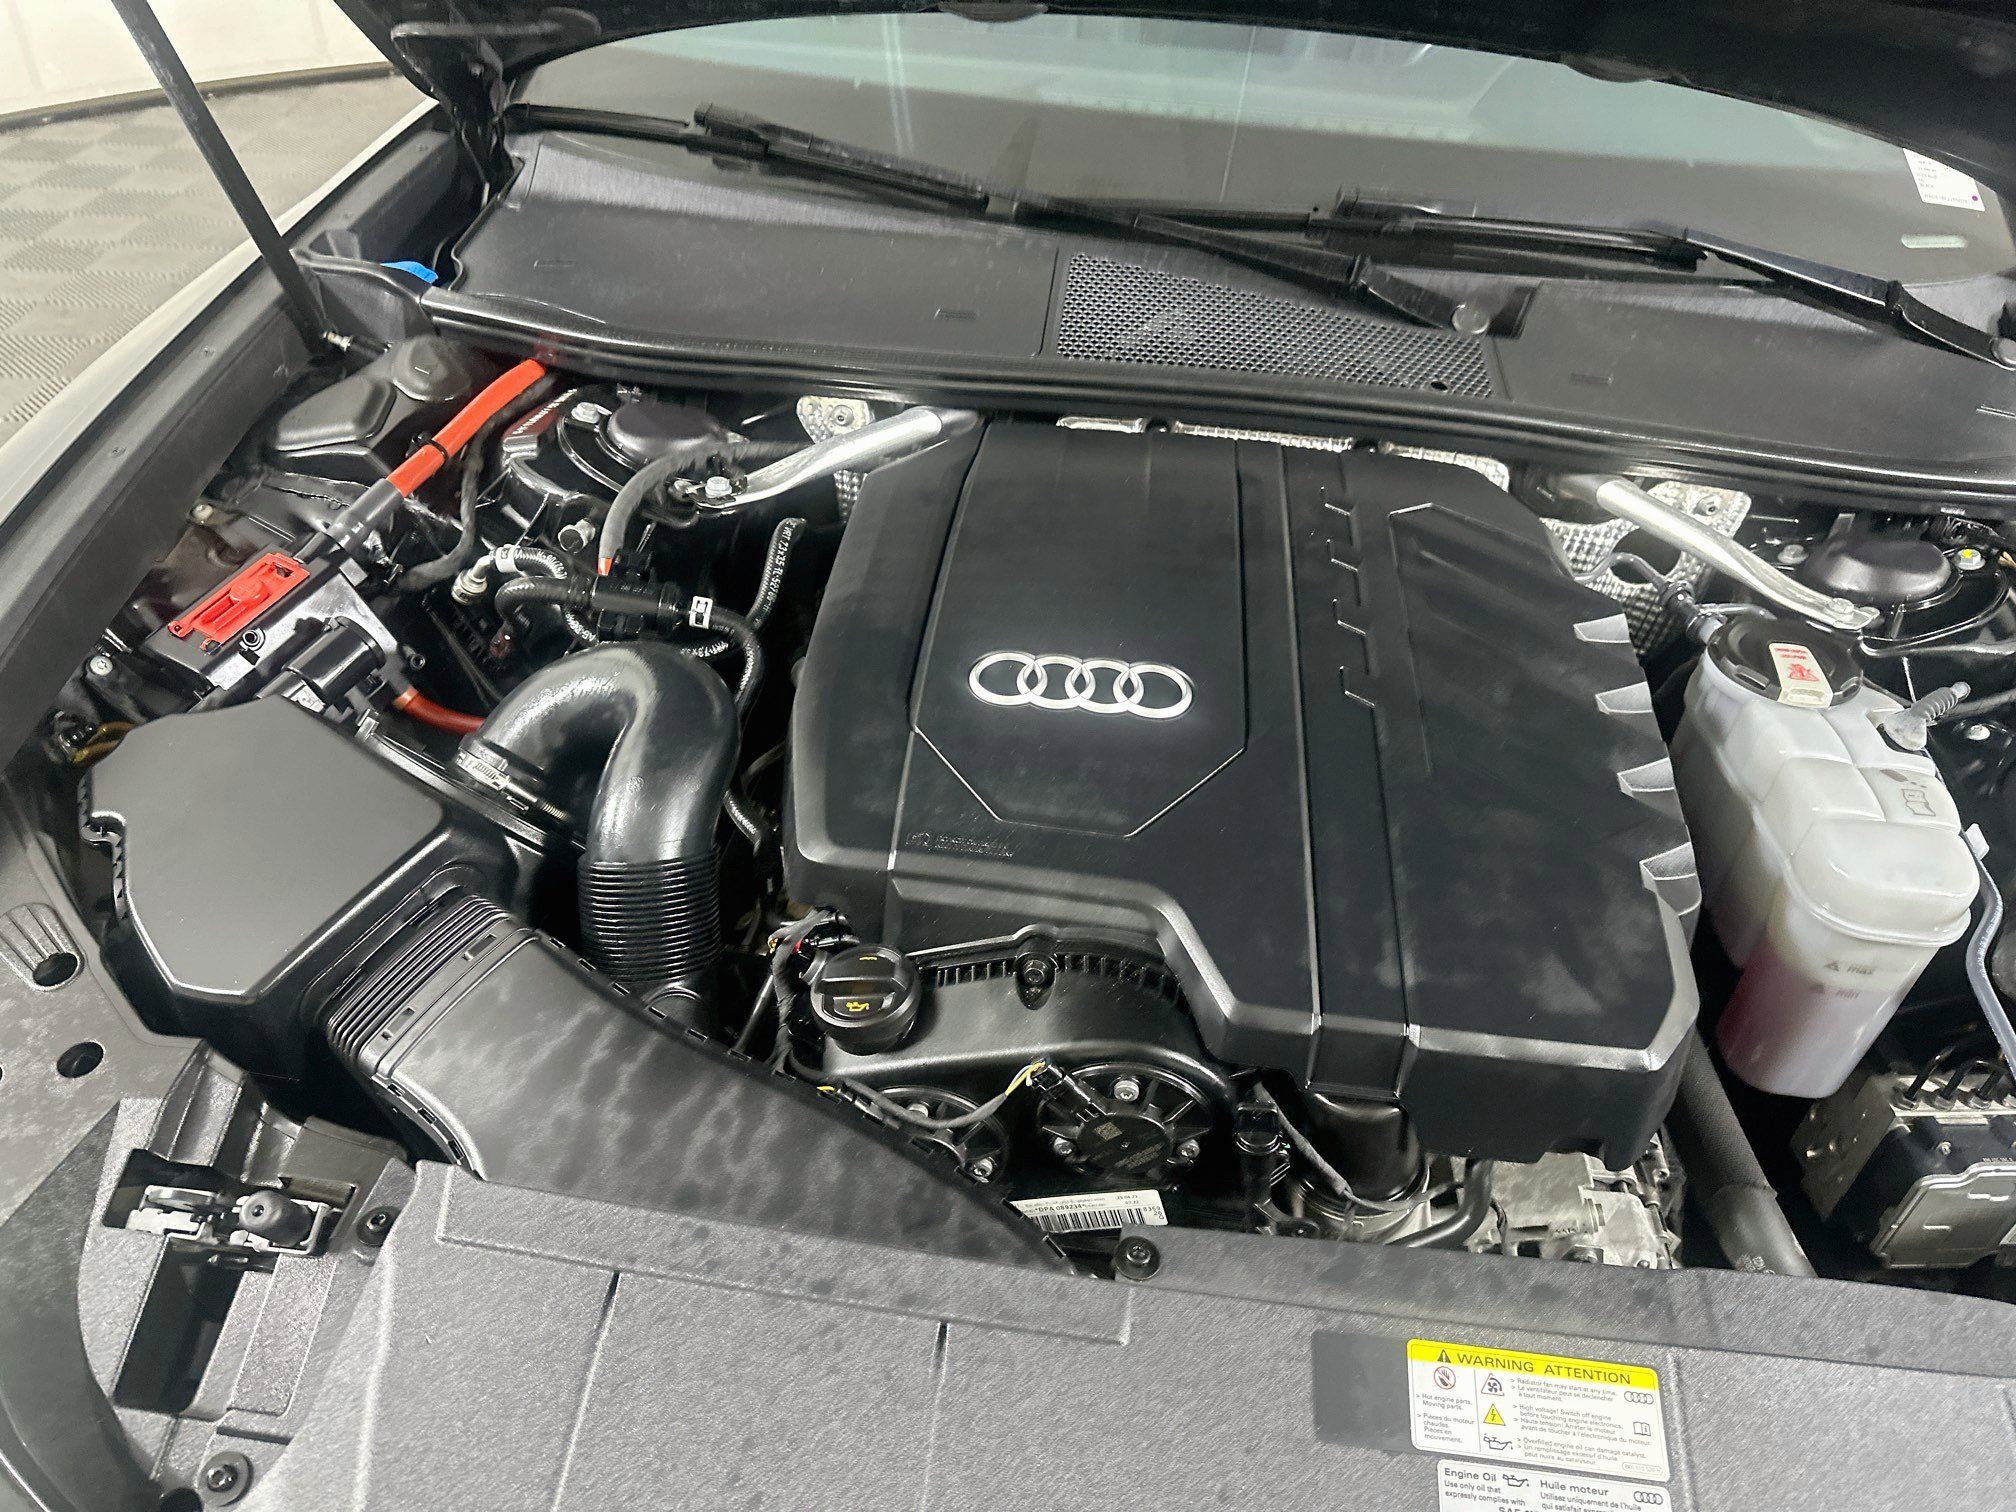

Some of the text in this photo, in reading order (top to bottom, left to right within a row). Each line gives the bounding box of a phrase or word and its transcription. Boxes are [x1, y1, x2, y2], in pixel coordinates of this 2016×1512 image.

[1457, 1353, 1631, 1385] WARNING ATTENTION
[1517, 1377, 1542, 1387] Radiator
[1422, 1400, 1446, 1409] Moving
[1519, 1403, 1533, 1411] High
[1591, 1414, 1612, 1422] engine
[1519, 1410, 1539, 1418] before
[1540, 1413, 1567, 1423] touching
[1452, 1417, 1475, 1425] moteur
[1520, 1417, 1539, 1425] Haute
[1521, 1424, 1538, 1432] avant
[1523, 1437, 1553, 1447] Overfilled
[1553, 1442, 1575, 1450] engine
[1444, 1467, 1497, 1482] Engine Oil
[1444, 1480, 1502, 1494] Use only oil that
[1540, 1480, 1609, 1497] Huile moteur
[1444, 1490, 1526, 1506] expressly complies with
[1540, 1491, 1567, 1502] Utilisez
[1566, 1496, 1609, 1507] uniquement
[1609, 1501, 1619, 1509] de
[1541, 1503, 1554, 1511] qui
